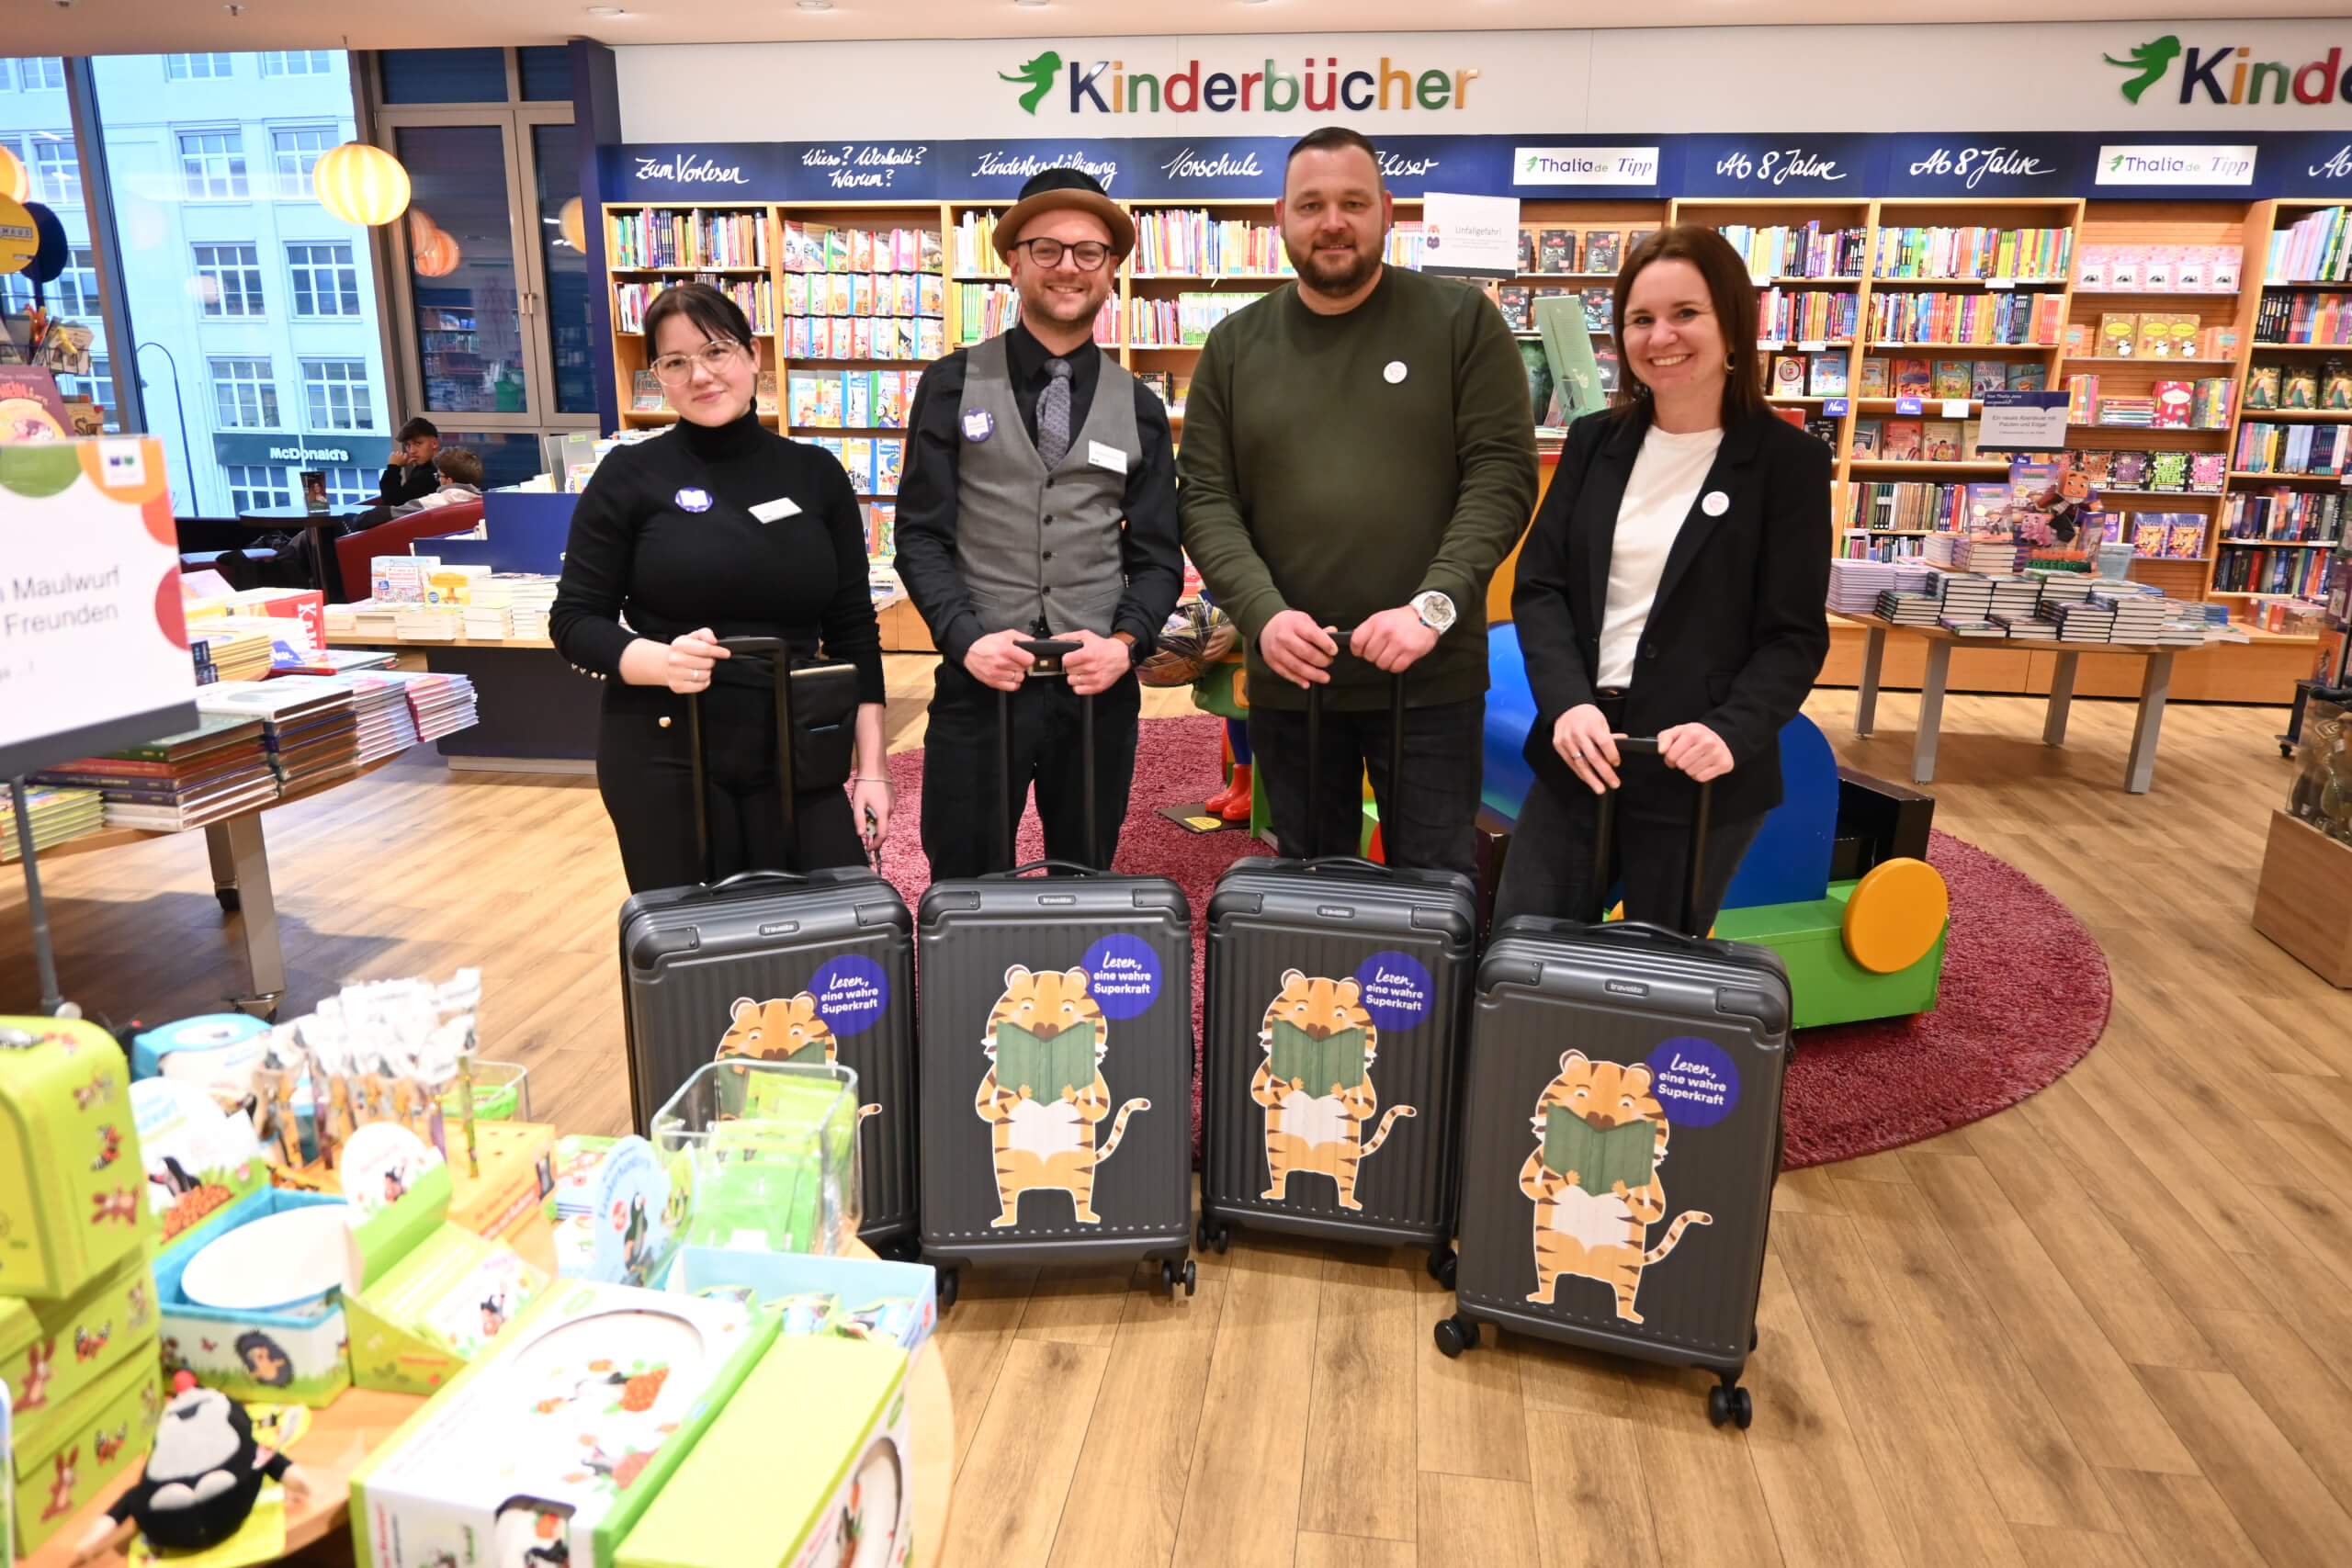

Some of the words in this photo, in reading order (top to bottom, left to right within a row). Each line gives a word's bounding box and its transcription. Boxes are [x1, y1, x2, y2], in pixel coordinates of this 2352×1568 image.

[1069, 57, 1478, 113] Kinderbücher
[802, 146, 854, 166] Wieso?
[854, 146, 927, 165] Weshalb?
[1161, 148, 1263, 179] Vorschule
[2211, 157, 2249, 176] Tipp
[635, 158, 675, 179] Zum
[676, 154, 750, 184] Vorlesen
[1618, 158, 1652, 176] Tipp
[1717, 152, 1751, 179] Ab
[1757, 151, 1779, 179] 8
[1774, 149, 1847, 185] Jahre
[1910, 149, 1951, 175] Ab
[1954, 148, 1978, 175] 8
[1966, 147, 2058, 189] Jahre
[270, 447, 349, 461] McDonald's
[12, 564, 119, 601] Maulwurf
[4, 603, 119, 637] Freunden
[1102, 950, 1143, 971] Lesen,
[830, 972, 869, 990] Lesen,
[1093, 970, 1116, 981] eine
[1118, 970, 1151, 981] wahre
[1375, 966, 1415, 988] Lesen,
[820, 991, 843, 1001] eine
[845, 987, 879, 999] wahre
[1093, 983, 1150, 996] Superkraft
[1365, 983, 1389, 994] eine
[1390, 987, 1423, 999] wahre
[821, 998, 878, 1014] Superkraft
[1365, 994, 1422, 1010] Superkraft
[1670, 1053, 1716, 1079] Lesen,
[1658, 1071, 1685, 1084] eine
[1687, 1079, 1726, 1092] wahre
[1657, 1083, 1724, 1106] Superkraft
